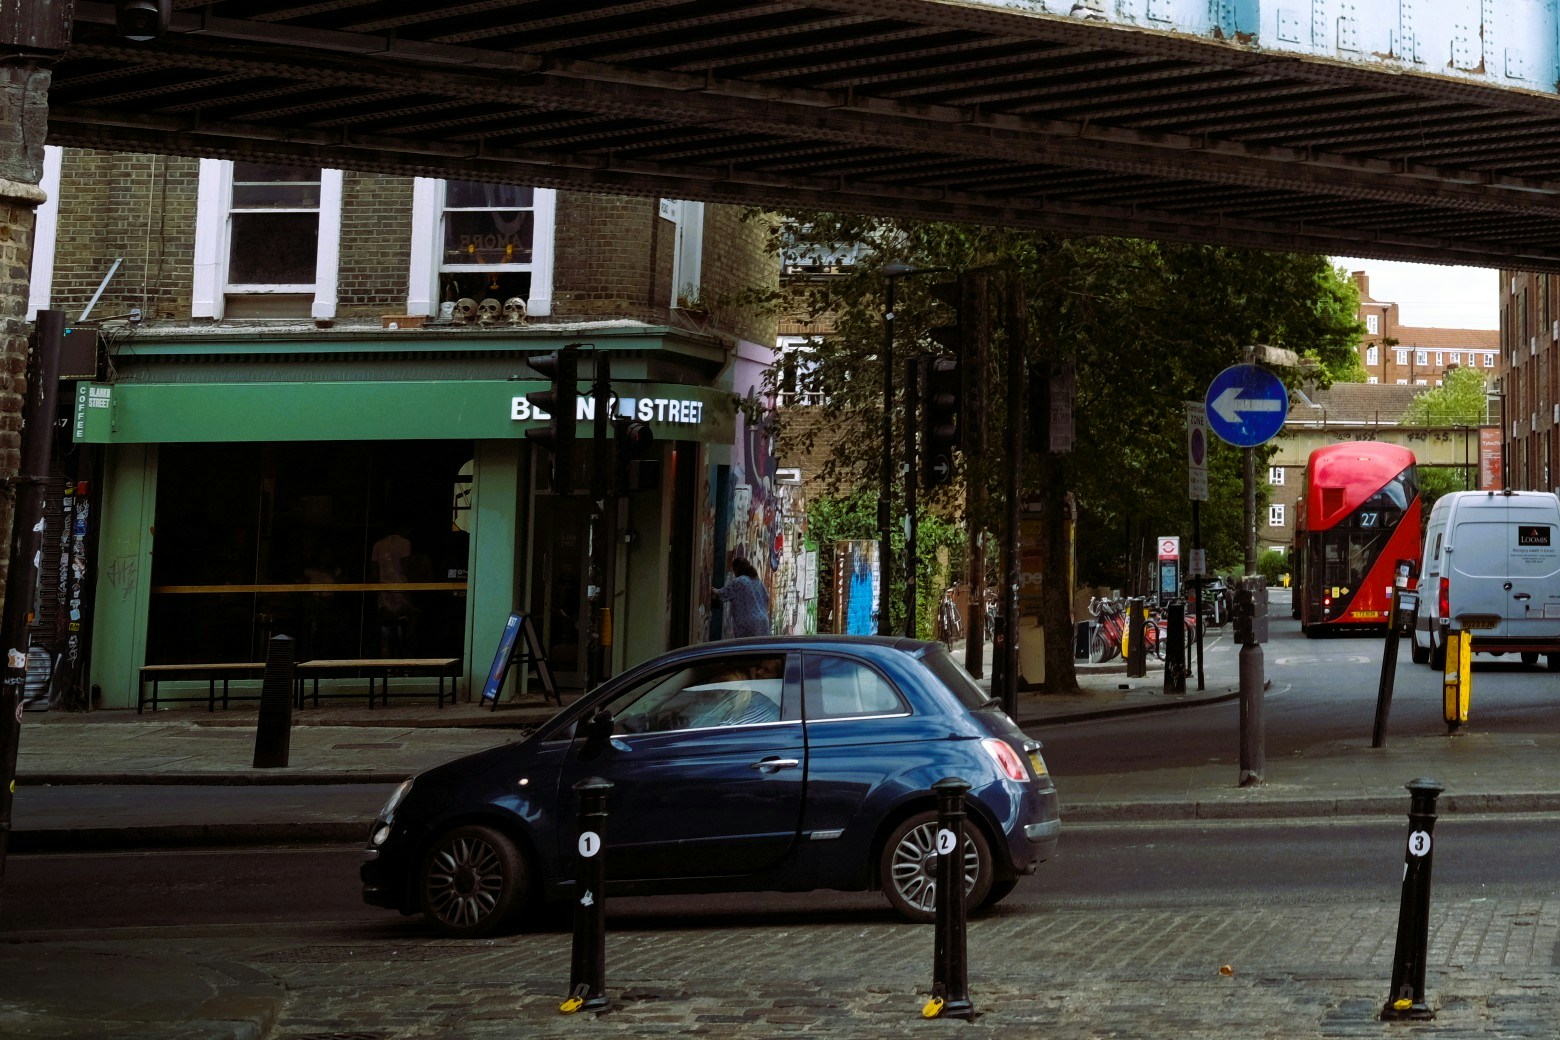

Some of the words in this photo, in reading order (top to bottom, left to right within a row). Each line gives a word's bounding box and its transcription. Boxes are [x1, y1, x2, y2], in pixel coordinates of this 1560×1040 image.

[88, 398, 110, 409] STREET
[637, 398, 703, 424] STREET
[76, 386, 86, 438] COFFEE
[1190, 415, 1204, 426] ZONE
[1361, 513, 1377, 526] 27
[1521, 536, 1548, 544] LOOMIS
[584, 836, 592, 853] 1
[940, 833, 949, 850] 2
[1414, 835, 1424, 851] 3
